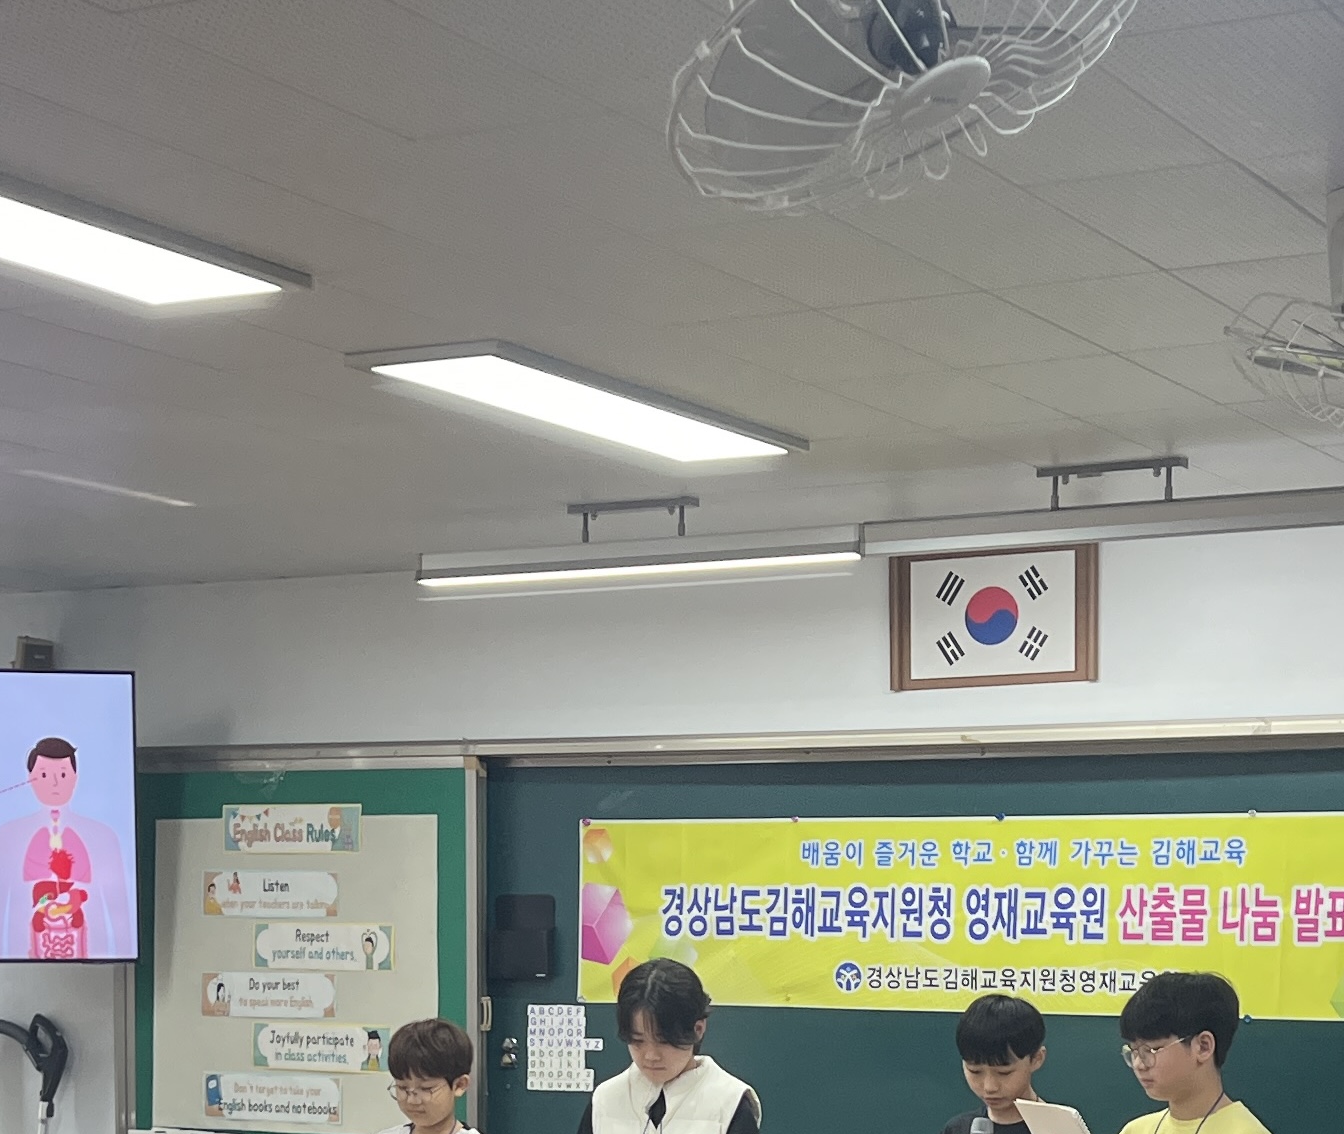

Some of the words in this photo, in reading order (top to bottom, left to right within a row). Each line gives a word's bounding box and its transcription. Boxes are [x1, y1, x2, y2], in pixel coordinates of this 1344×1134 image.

[234, 823, 270, 847] English
[274, 823, 302, 842] Class
[307, 824, 335, 842] Rules
[801, 841, 863, 867] 배움이
[874, 841, 939, 867] 즐거운
[1071, 840, 1138, 867] 가꾸는
[1153, 839, 1246, 866] 김해교육
[264, 879, 289, 892] Listen
[662, 886, 953, 940] 경상남도김해교육지원청
[966, 885, 1105, 942] 영재교육원
[1119, 887, 1207, 943] 산출물
[1221, 887, 1281, 943] 나눔
[296, 929, 329, 946] Respect
[272, 947, 305, 962] yourself
[308, 949, 323, 960] and
[249, 978, 259, 990] Do
[262, 981, 280, 993] your
[283, 978, 299, 991] best
[270, 1031, 304, 1047] Joyfully
[306, 1032, 354, 1049] participate
[275, 1051, 282, 1061] in
[284, 1049, 304, 1061] class
[219, 1099, 245, 1115] English
[248, 1100, 272, 1113] books
[275, 1102, 290, 1114] and
